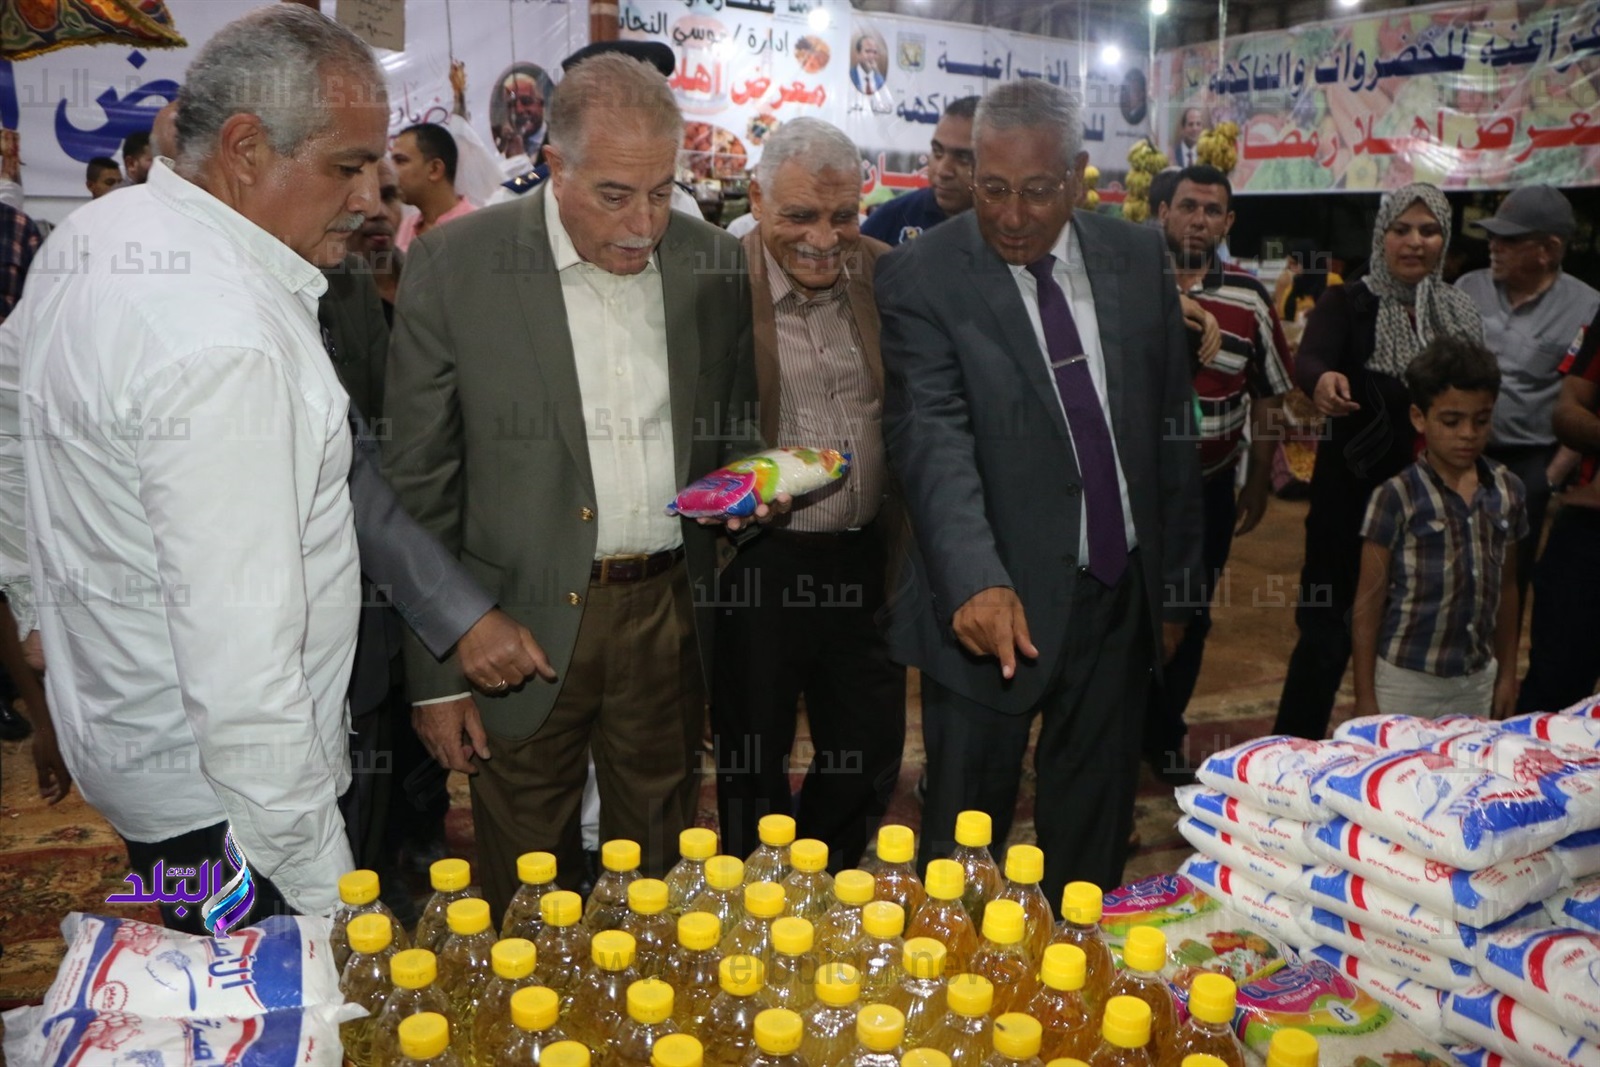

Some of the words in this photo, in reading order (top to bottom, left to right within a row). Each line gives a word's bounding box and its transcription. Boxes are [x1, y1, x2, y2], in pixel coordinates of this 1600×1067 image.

[748, 28, 789, 56] إدارة
[1313, 26, 1466, 93] للخضروات
[730, 66, 827, 109] معرض
[1242, 119, 1339, 168] رمضا
[1353, 111, 1444, 156] اهلا
